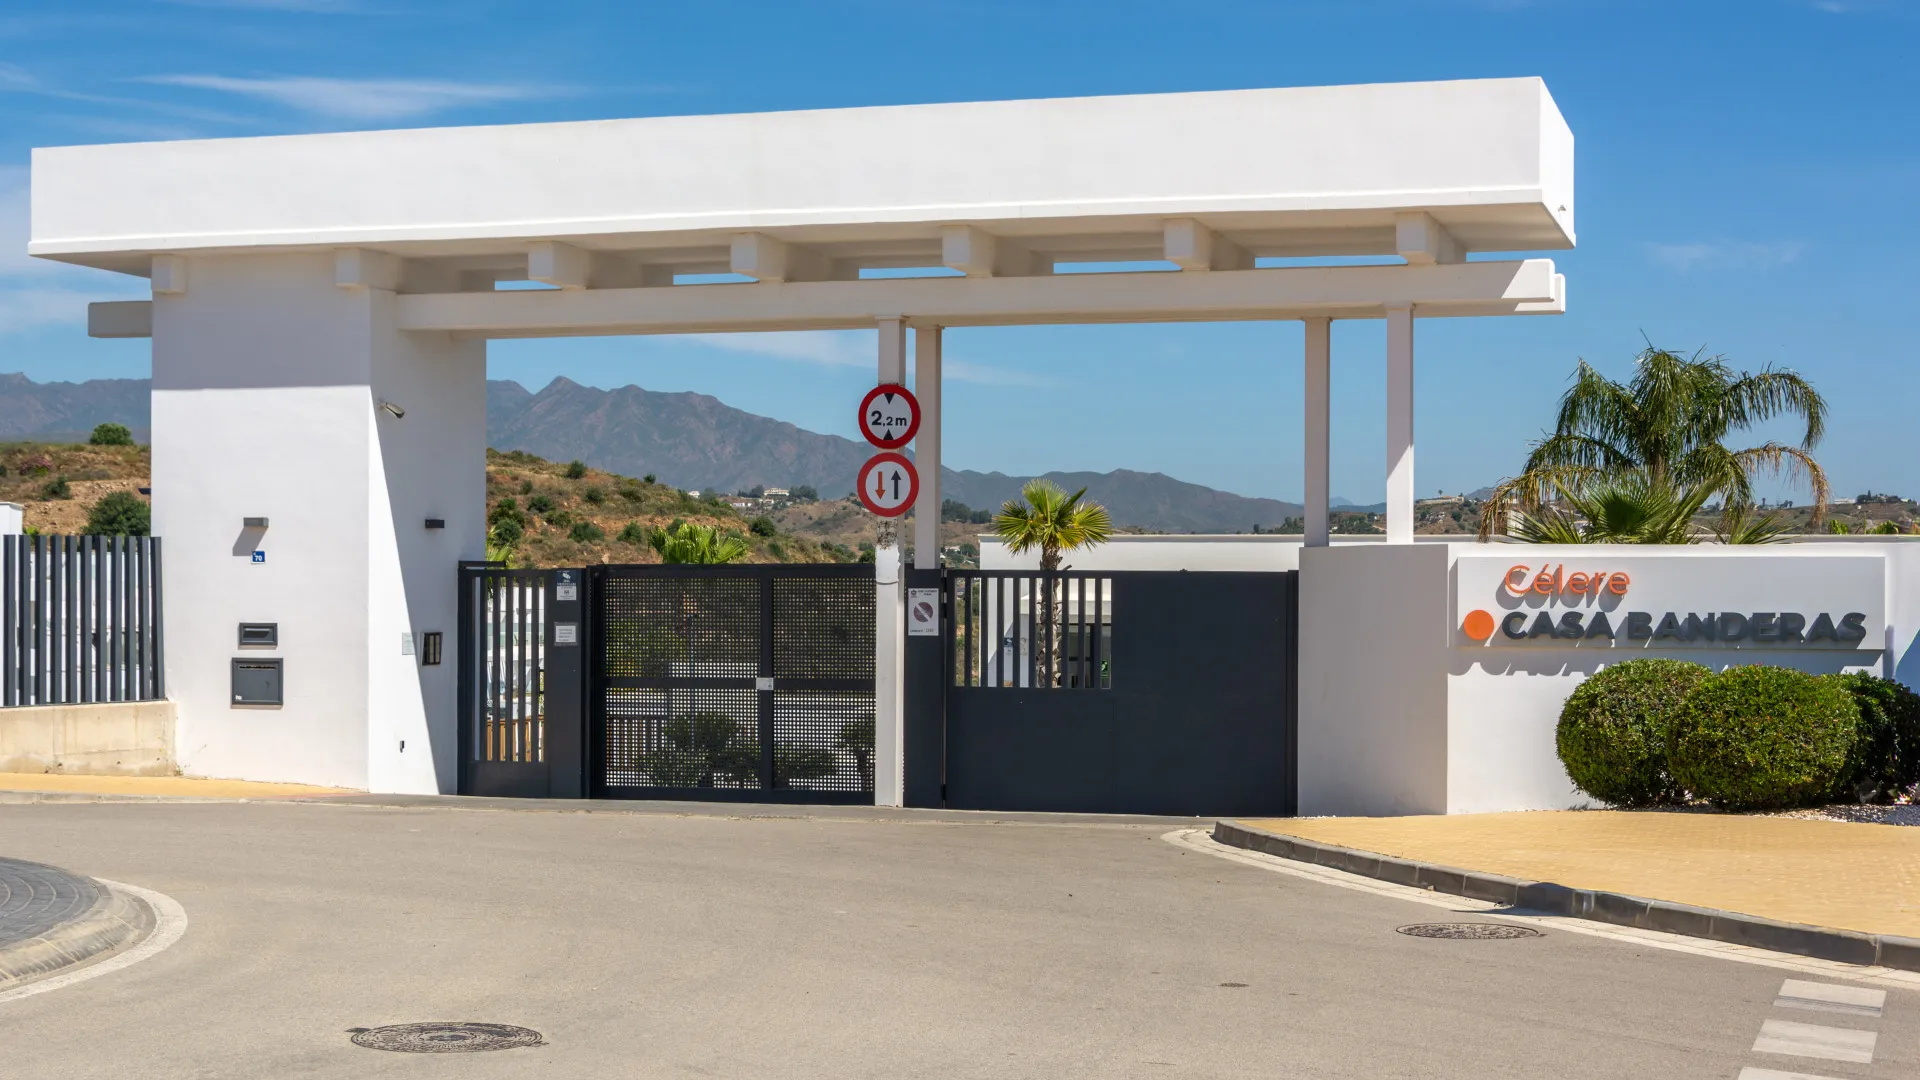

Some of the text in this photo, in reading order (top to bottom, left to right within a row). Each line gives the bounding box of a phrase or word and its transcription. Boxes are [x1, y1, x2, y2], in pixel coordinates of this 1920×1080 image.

[1505, 564, 1630, 595] Célere
[1502, 611, 1867, 641] CASA BANDERAS
